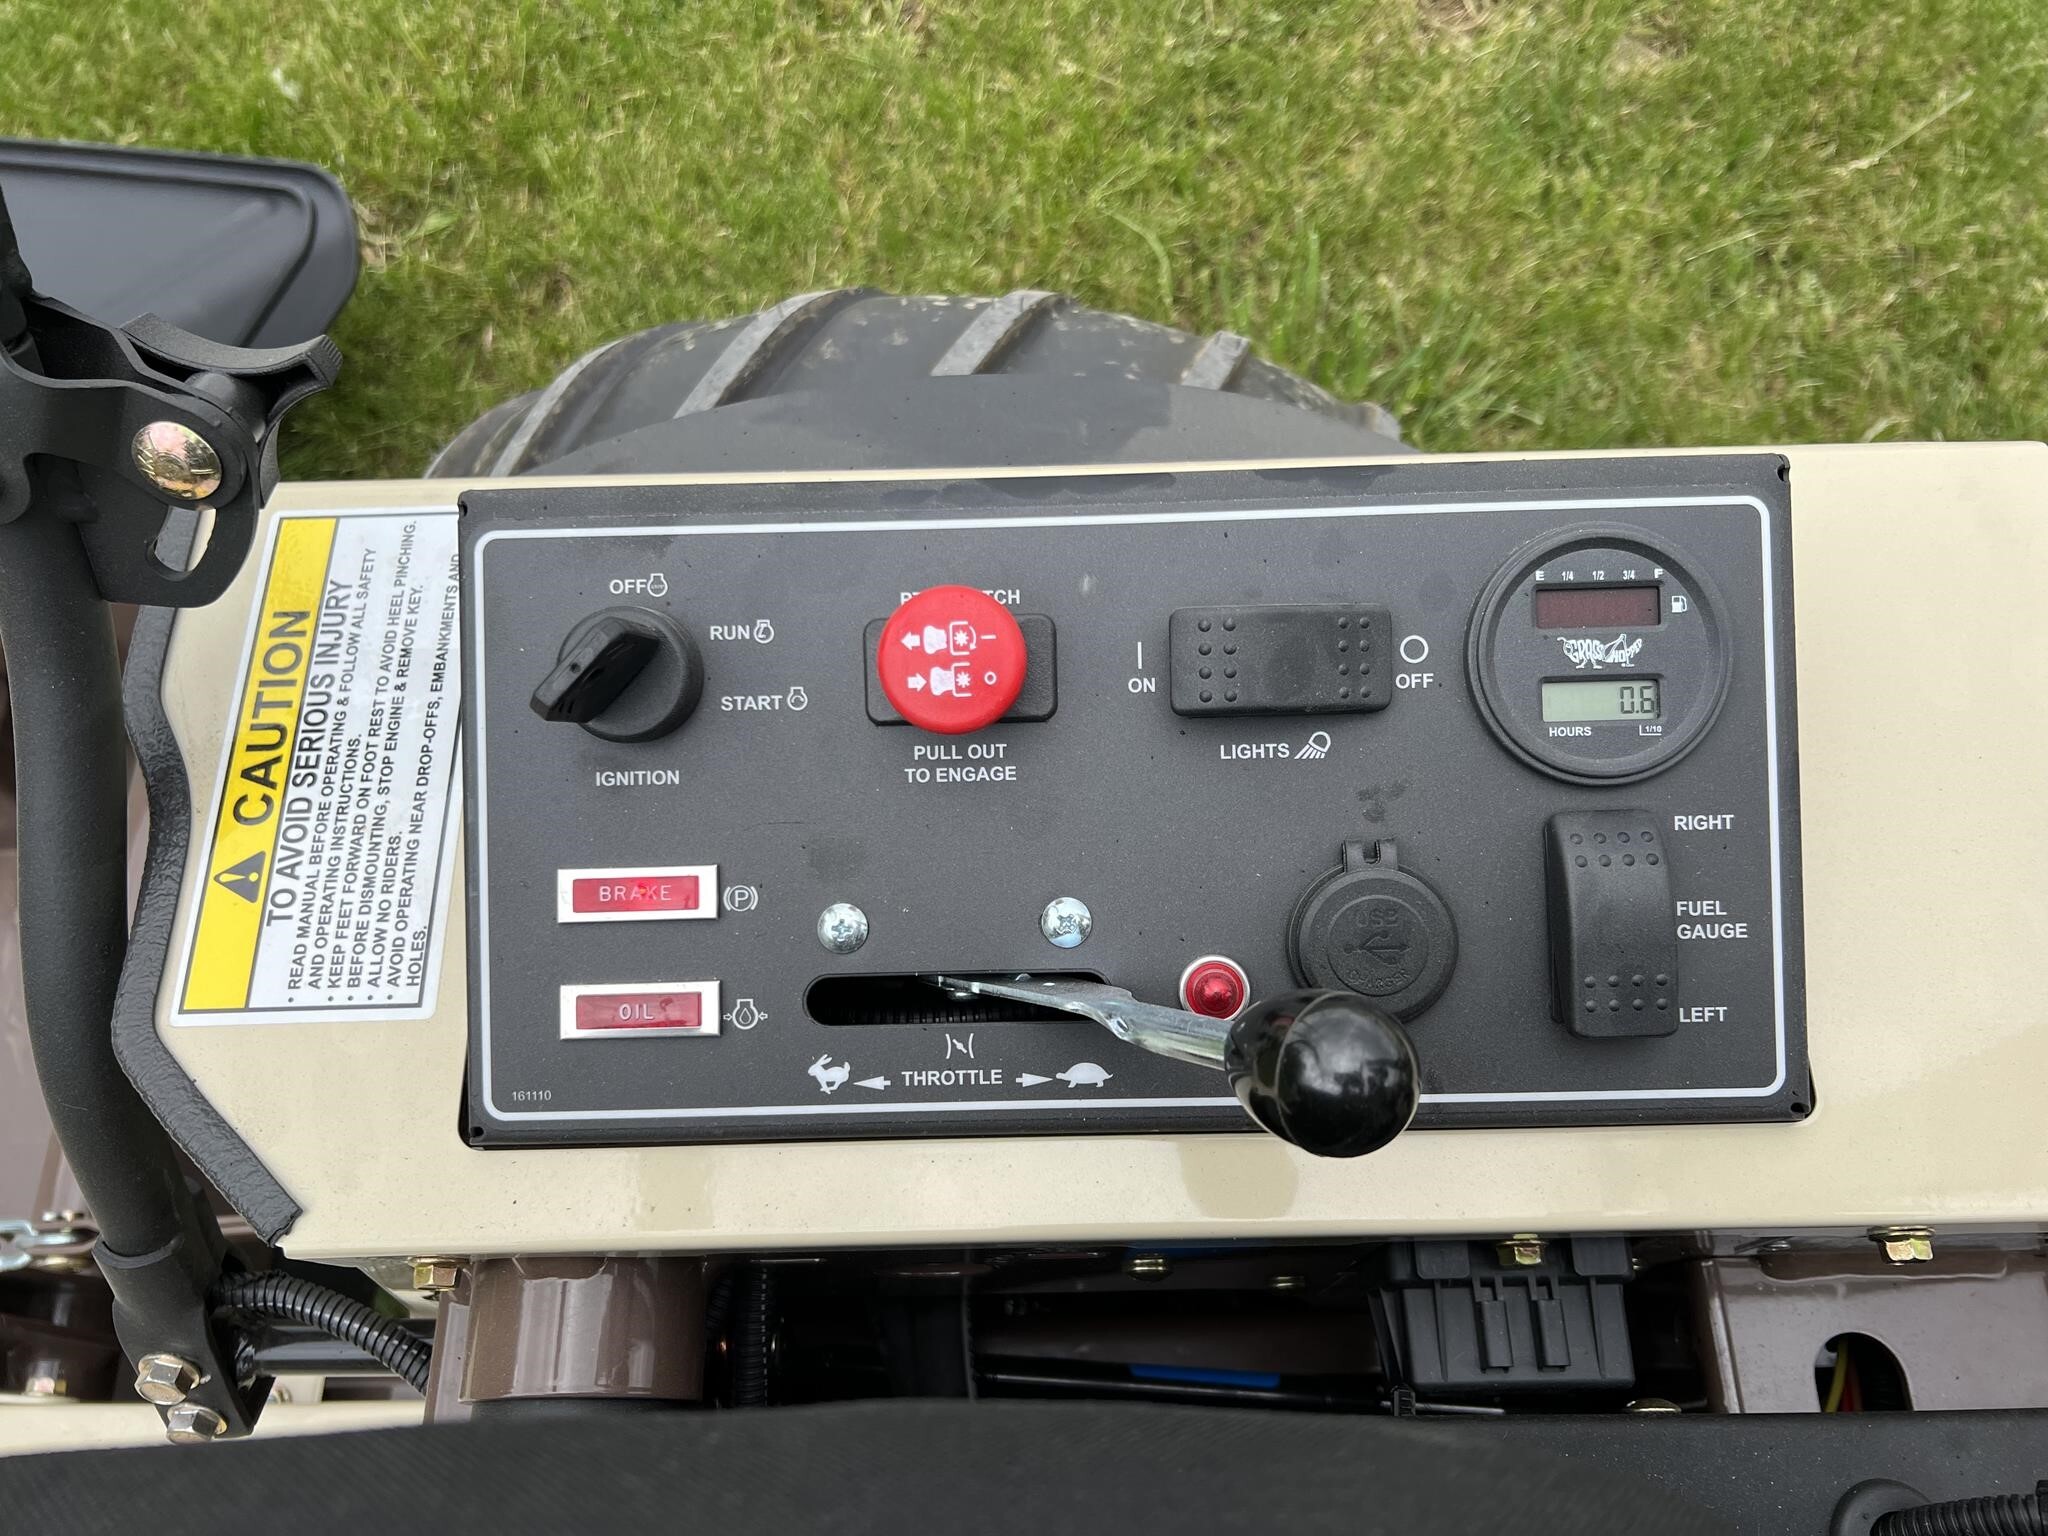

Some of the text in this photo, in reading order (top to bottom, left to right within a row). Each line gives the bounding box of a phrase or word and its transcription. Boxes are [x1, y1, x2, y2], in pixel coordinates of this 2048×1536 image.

[1535, 569, 1663, 581] E 1/4 1/2 3/4 F
[609, 579, 647, 595] OFF
[431, 585, 457, 692] EMBANKMENTS
[710, 624, 750, 640] RUN
[1127, 677, 1156, 693] ON
[1395, 673, 1434, 689] OFF
[720, 695, 783, 711] START
[233, 611, 311, 826] CAUTION
[1549, 725, 1662, 737] HOURS 1/10
[416, 696, 442, 787] DROP-OFFS,
[266, 580, 352, 927] TO AVOID SERIOUS INJURY
[327, 521, 416, 988] KEEP FEET FORWARD ON FOOT REST TO AVOID HEEL PINCHING.
[913, 744, 1007, 760] PULL OUT
[1220, 743, 1290, 760] LIGHTS
[288, 549, 376, 989] READ MANUAL BEFORE OPERATING & FOLLOW ALL SAFETY
[595, 769, 680, 787] IGNITION
[904, 766, 1017, 783] TO ENGAGE
[347, 585, 423, 988] BEFORE DISMOUNTING, STOP ENGINE & REMOVE KEY.
[409, 791, 427, 834] NEAR
[1674, 814, 1734, 831] RIGHT
[308, 733, 362, 989] AND OPERATING INSTRUCTIONS.
[395, 839, 420, 931] OPERATING
[600, 884, 672, 902] BRAKE
[367, 831, 402, 988] ALLOW NO RIDERS.
[1676, 901, 1727, 916] FUEL
[1356, 908, 1399, 928] USB
[1677, 923, 1748, 940] GAUGE
[387, 937, 405, 988] AVOID
[406, 926, 427, 986] HOLES.
[620, 1003, 654, 1020] OIL
[1679, 1006, 1728, 1023] LEFT
[901, 1069, 1003, 1087] THROTTLE
[512, 1090, 552, 1101] 161110
